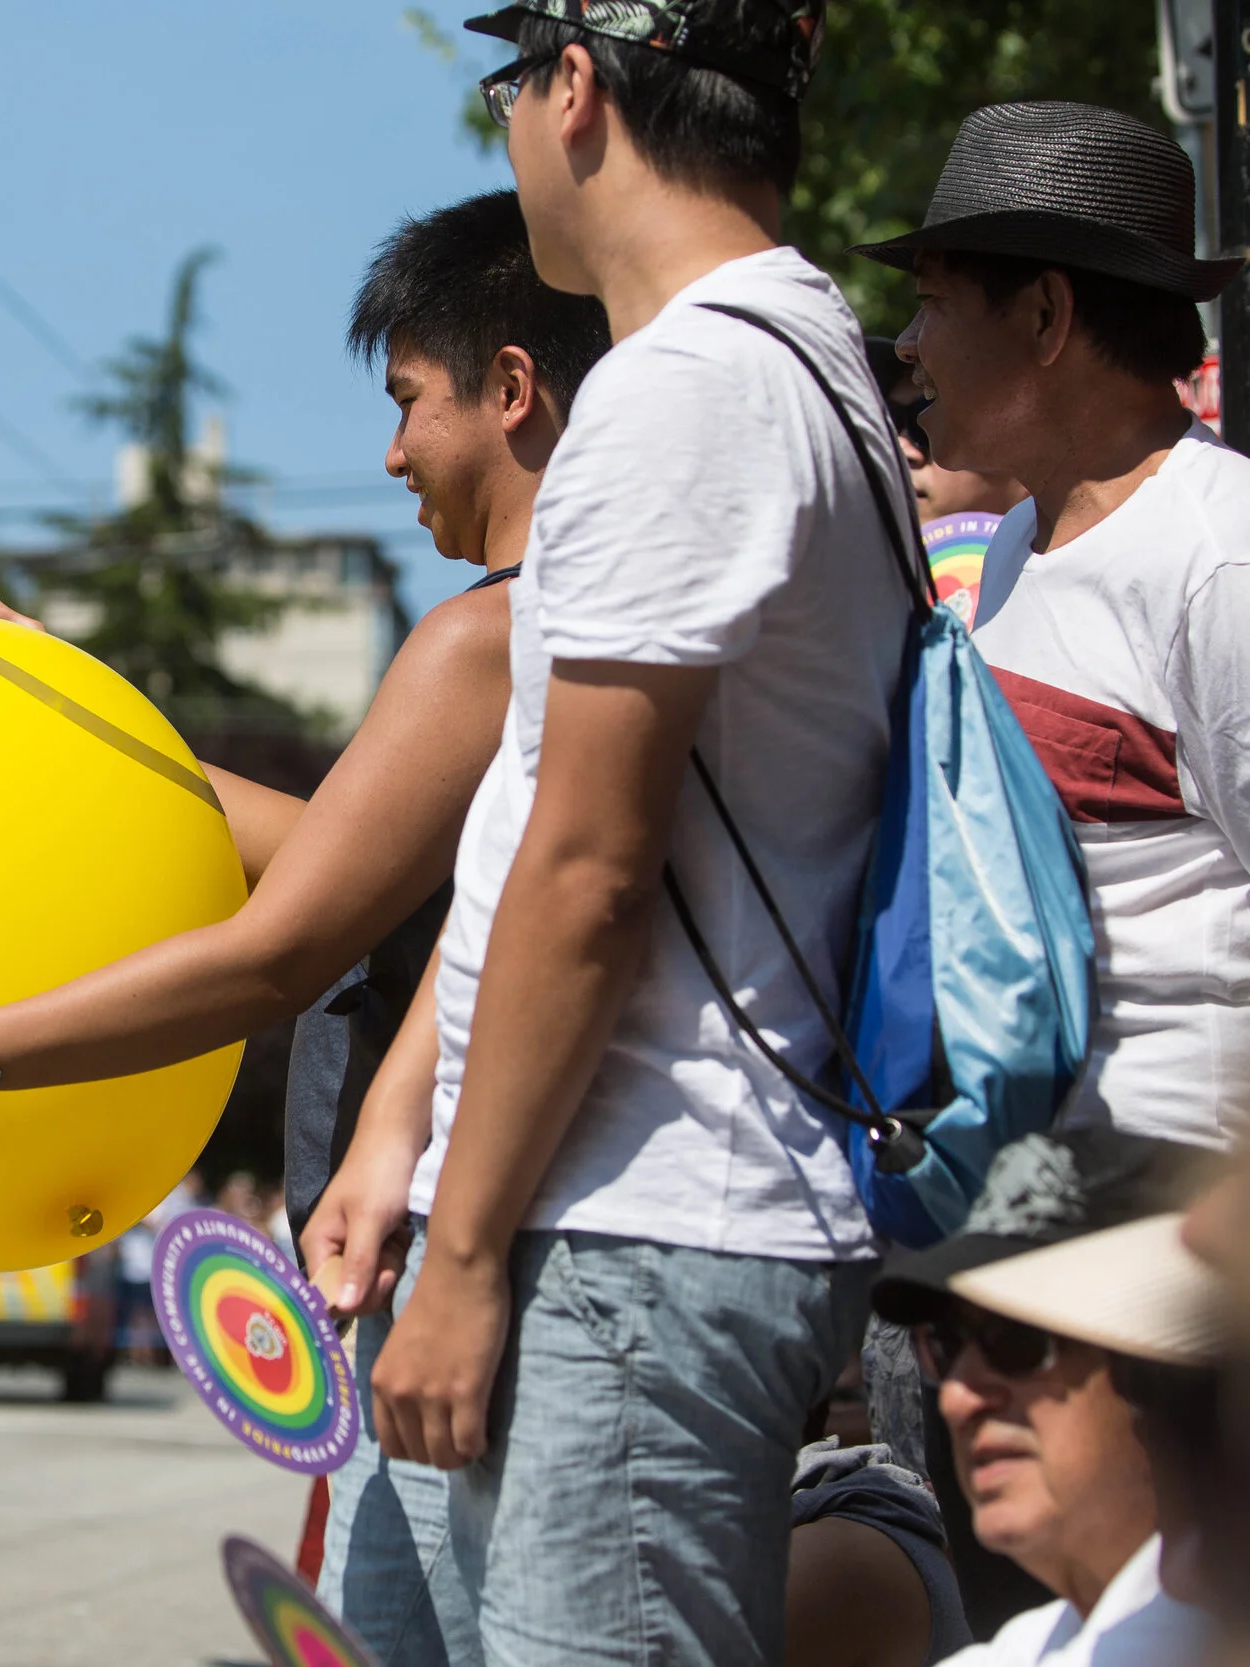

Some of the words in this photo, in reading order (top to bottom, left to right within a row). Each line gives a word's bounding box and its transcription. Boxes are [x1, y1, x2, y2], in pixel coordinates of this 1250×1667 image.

[959, 520, 978, 533] IN
[193, 1219, 286, 1275] COMMUNITY
[162, 1234, 188, 1347] COMMUNITY
[290, 1274, 318, 1313] THE
[317, 1318, 332, 1343] IN
[185, 1355, 213, 1393] THE
[216, 1397, 237, 1422] IN
